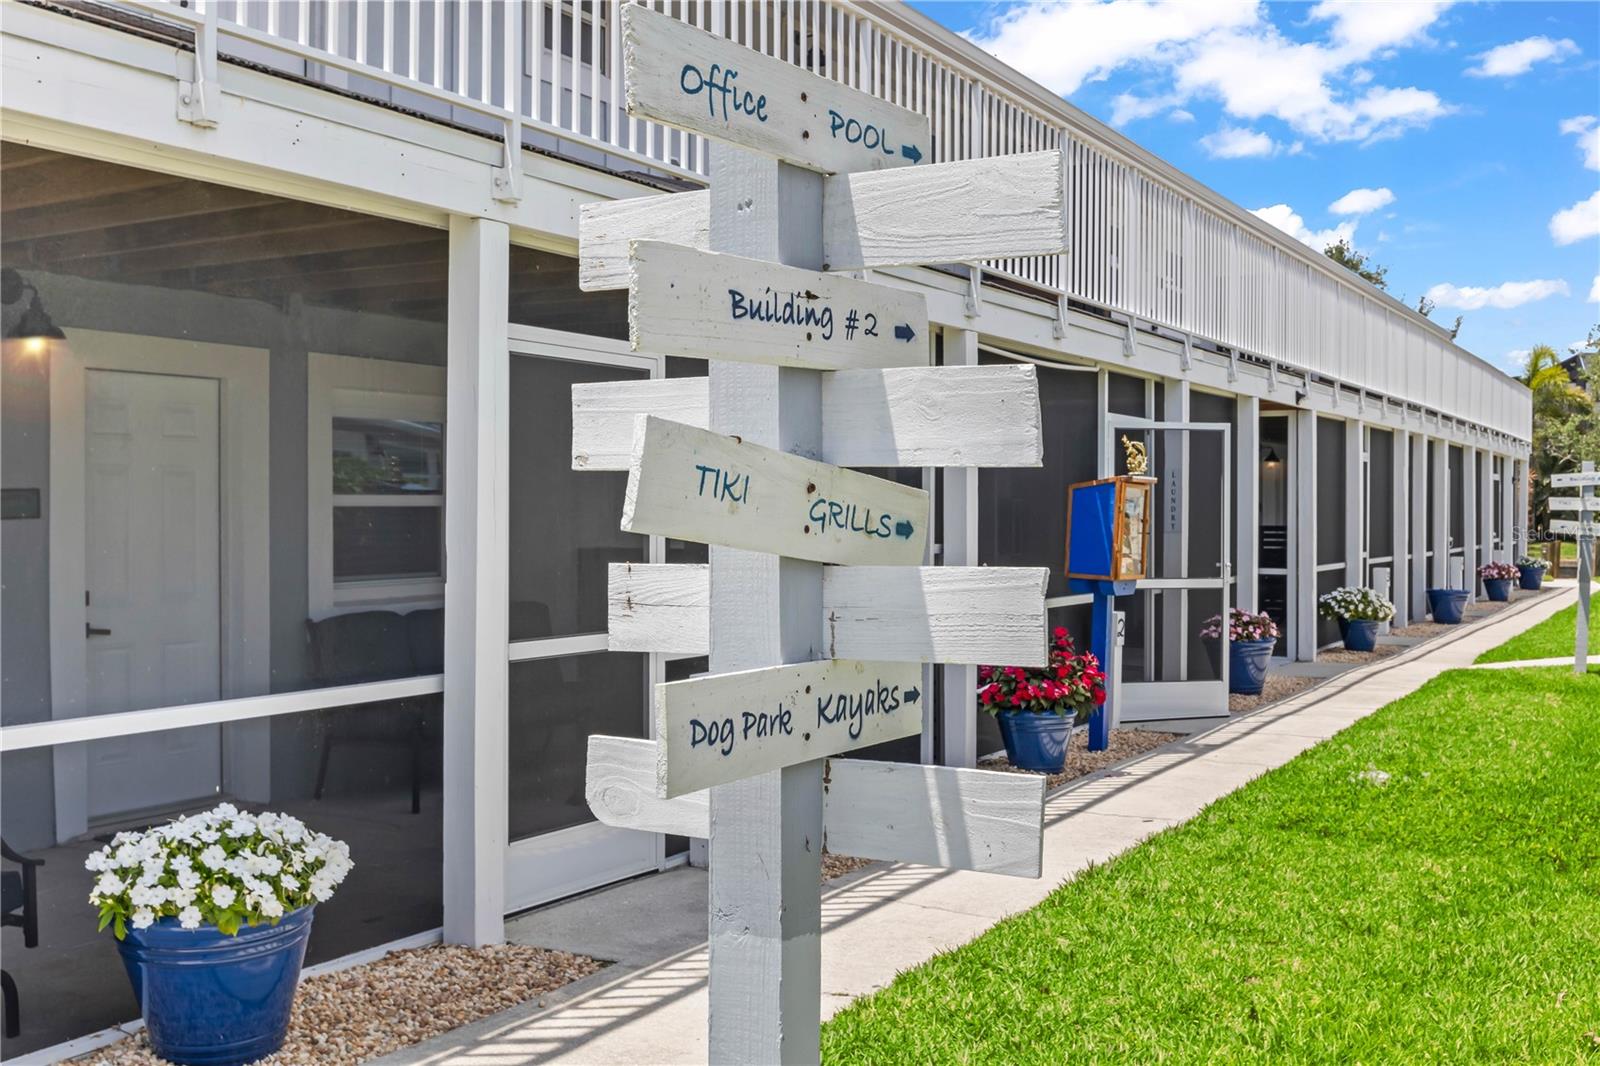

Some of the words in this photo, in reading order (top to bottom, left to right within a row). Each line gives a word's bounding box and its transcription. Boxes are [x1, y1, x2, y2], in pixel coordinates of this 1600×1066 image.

[680, 63, 768, 122] Office
[828, 109, 894, 155] POOL
[728, 287, 833, 340] Building
[845, 309, 878, 340] #2
[695, 465, 750, 504] TIKI
[809, 499, 892, 538] GRILLS
[1117, 618, 1125, 638] 2
[690, 718, 734, 756] Dog
[742, 703, 793, 740] Park
[817, 679, 900, 740] Kayaks
